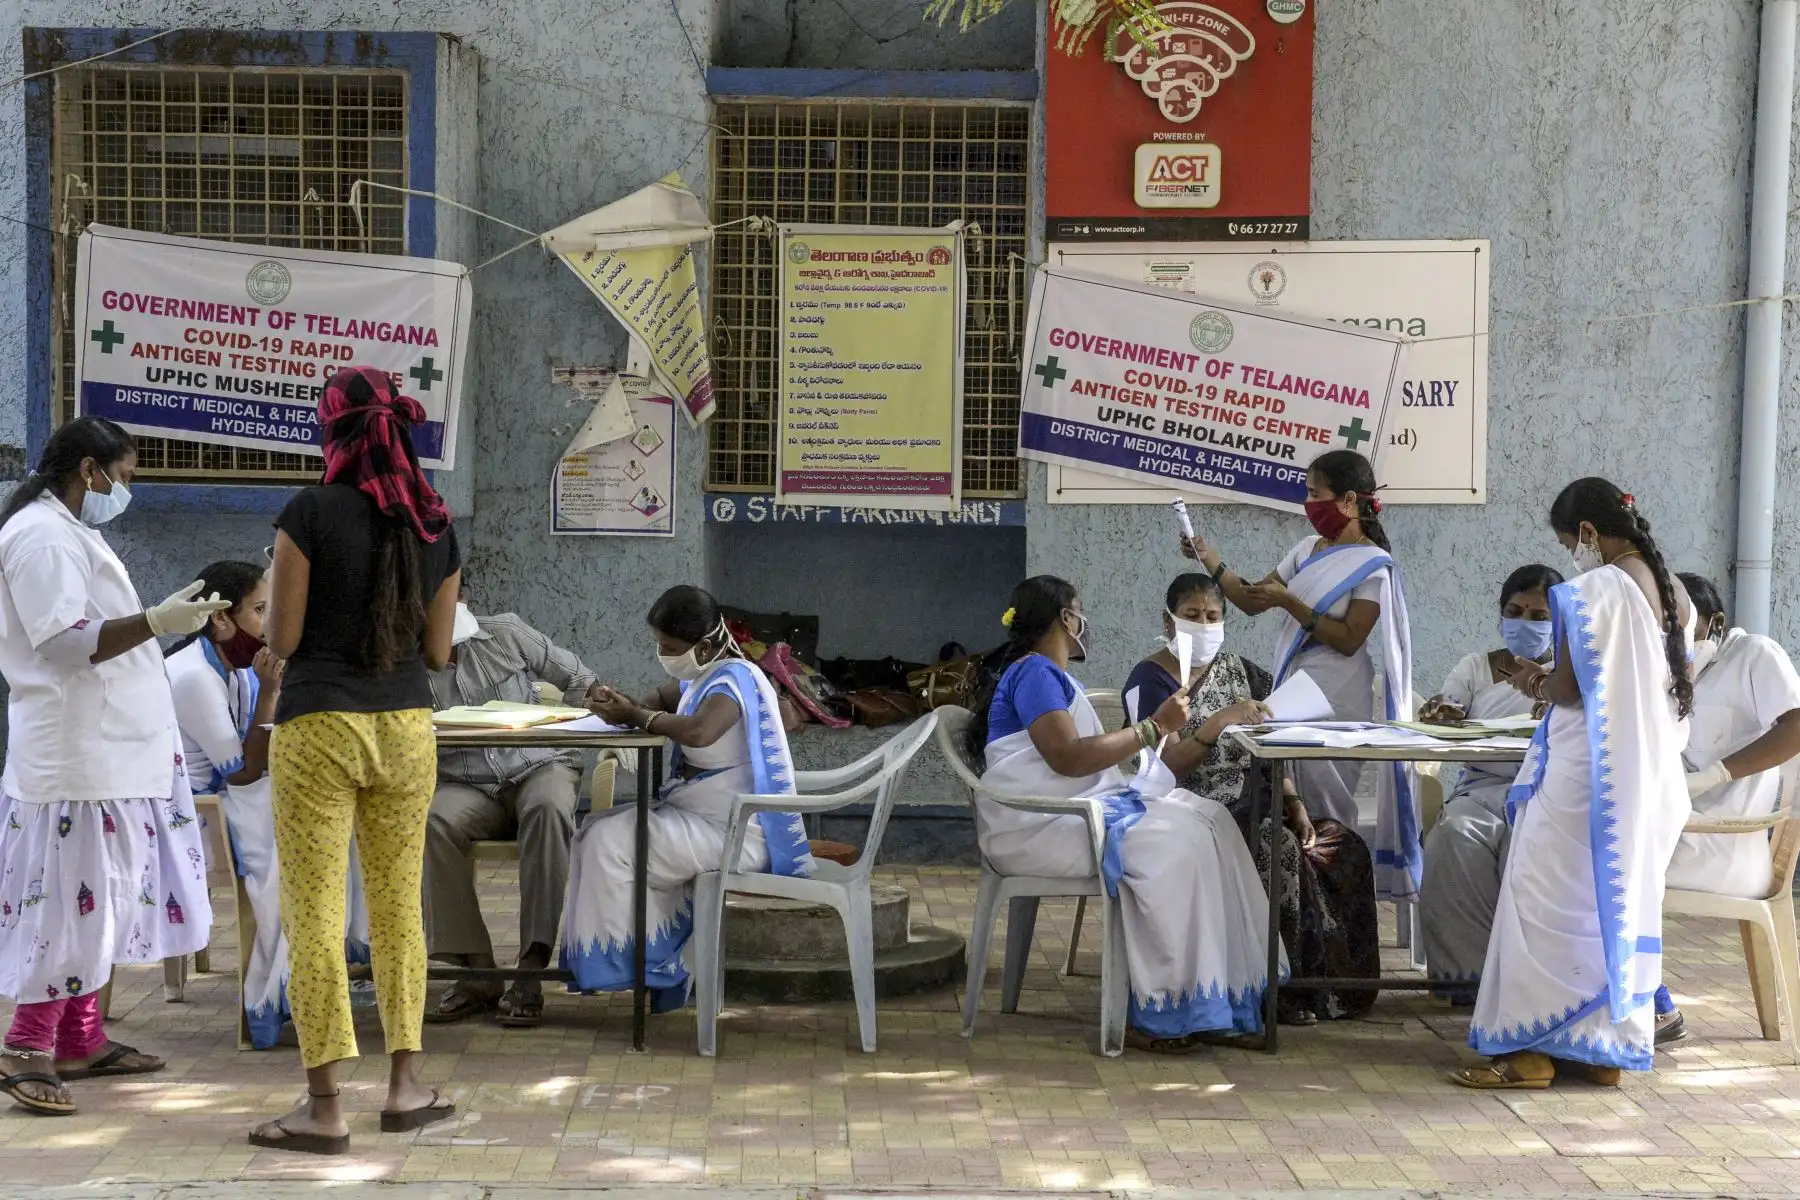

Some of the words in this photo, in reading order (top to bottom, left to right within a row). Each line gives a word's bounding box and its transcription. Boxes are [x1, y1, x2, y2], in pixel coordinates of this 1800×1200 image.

[1271, 2, 1301, 11] GHMC
[1196, 16, 1231, 36] ZONE
[1153, 132, 1193, 141] POWERED
[1194, 133, 1206, 141] BY
[1149, 156, 1208, 182] ACT
[1145, 184, 1210, 193] FIBERNET
[1094, 225, 1145, 234] www.actcorp.in
[1240, 223, 1254, 234] 66
[1255, 223, 1269, 234] 27
[1270, 223, 1284, 234] 27
[1285, 223, 1298, 234] 27
[810, 249, 869, 263] తెలంగాణ
[871, 249, 924, 266] ప్రభుత్వం
[914, 285, 949, 294] (COVID-19)
[102, 290, 260, 327] GOVERNMENT
[268, 310, 296, 333] OF
[304, 314, 439, 348] TELANGANA
[821, 301, 842, 310] (Temp
[183, 328, 283, 354] COVID-19
[289, 340, 354, 362] RAPID
[130, 342, 221, 368] ANTIGEN
[230, 354, 316, 378] TESTING
[1049, 327, 1200, 374] GOVERNMENT
[1205, 358, 1234, 382] OF
[1241, 364, 1371, 410] TELANGANA
[145, 367, 208, 389] UPHC
[215, 375, 322, 402] MUSHEER
[629, 380, 651, 388] COVID-
[1123, 369, 1218, 402] COVID-19
[1222, 387, 1287, 415] RAPID
[1402, 380, 1460, 408] SARY
[115, 388, 189, 410] DISTRICT
[192, 396, 265, 421] MEDICAL
[269, 407, 280, 421] &
[285, 409, 318, 426] HEA
[1069, 379, 1158, 412] ANTIGEN
[1163, 397, 1248, 428] TESTING
[1252, 415, 1332, 445] CENTRE
[211, 417, 313, 442] HYDERABAD
[1097, 406, 1156, 433] UPHC
[1161, 420, 1297, 461] BHOLAKPUR
[1050, 421, 1121, 447] DISTRICT
[1122, 436, 1192, 462] MEDICAL
[1195, 450, 1206, 464] &
[1209, 455, 1273, 479] HEALTH
[1275, 467, 1308, 485] OFF
[1138, 456, 1236, 488] HYDERABAD
[746, 496, 832, 522] STAFF
[840, 506, 944, 526] PARKING
[948, 501, 1001, 526] ONLY
